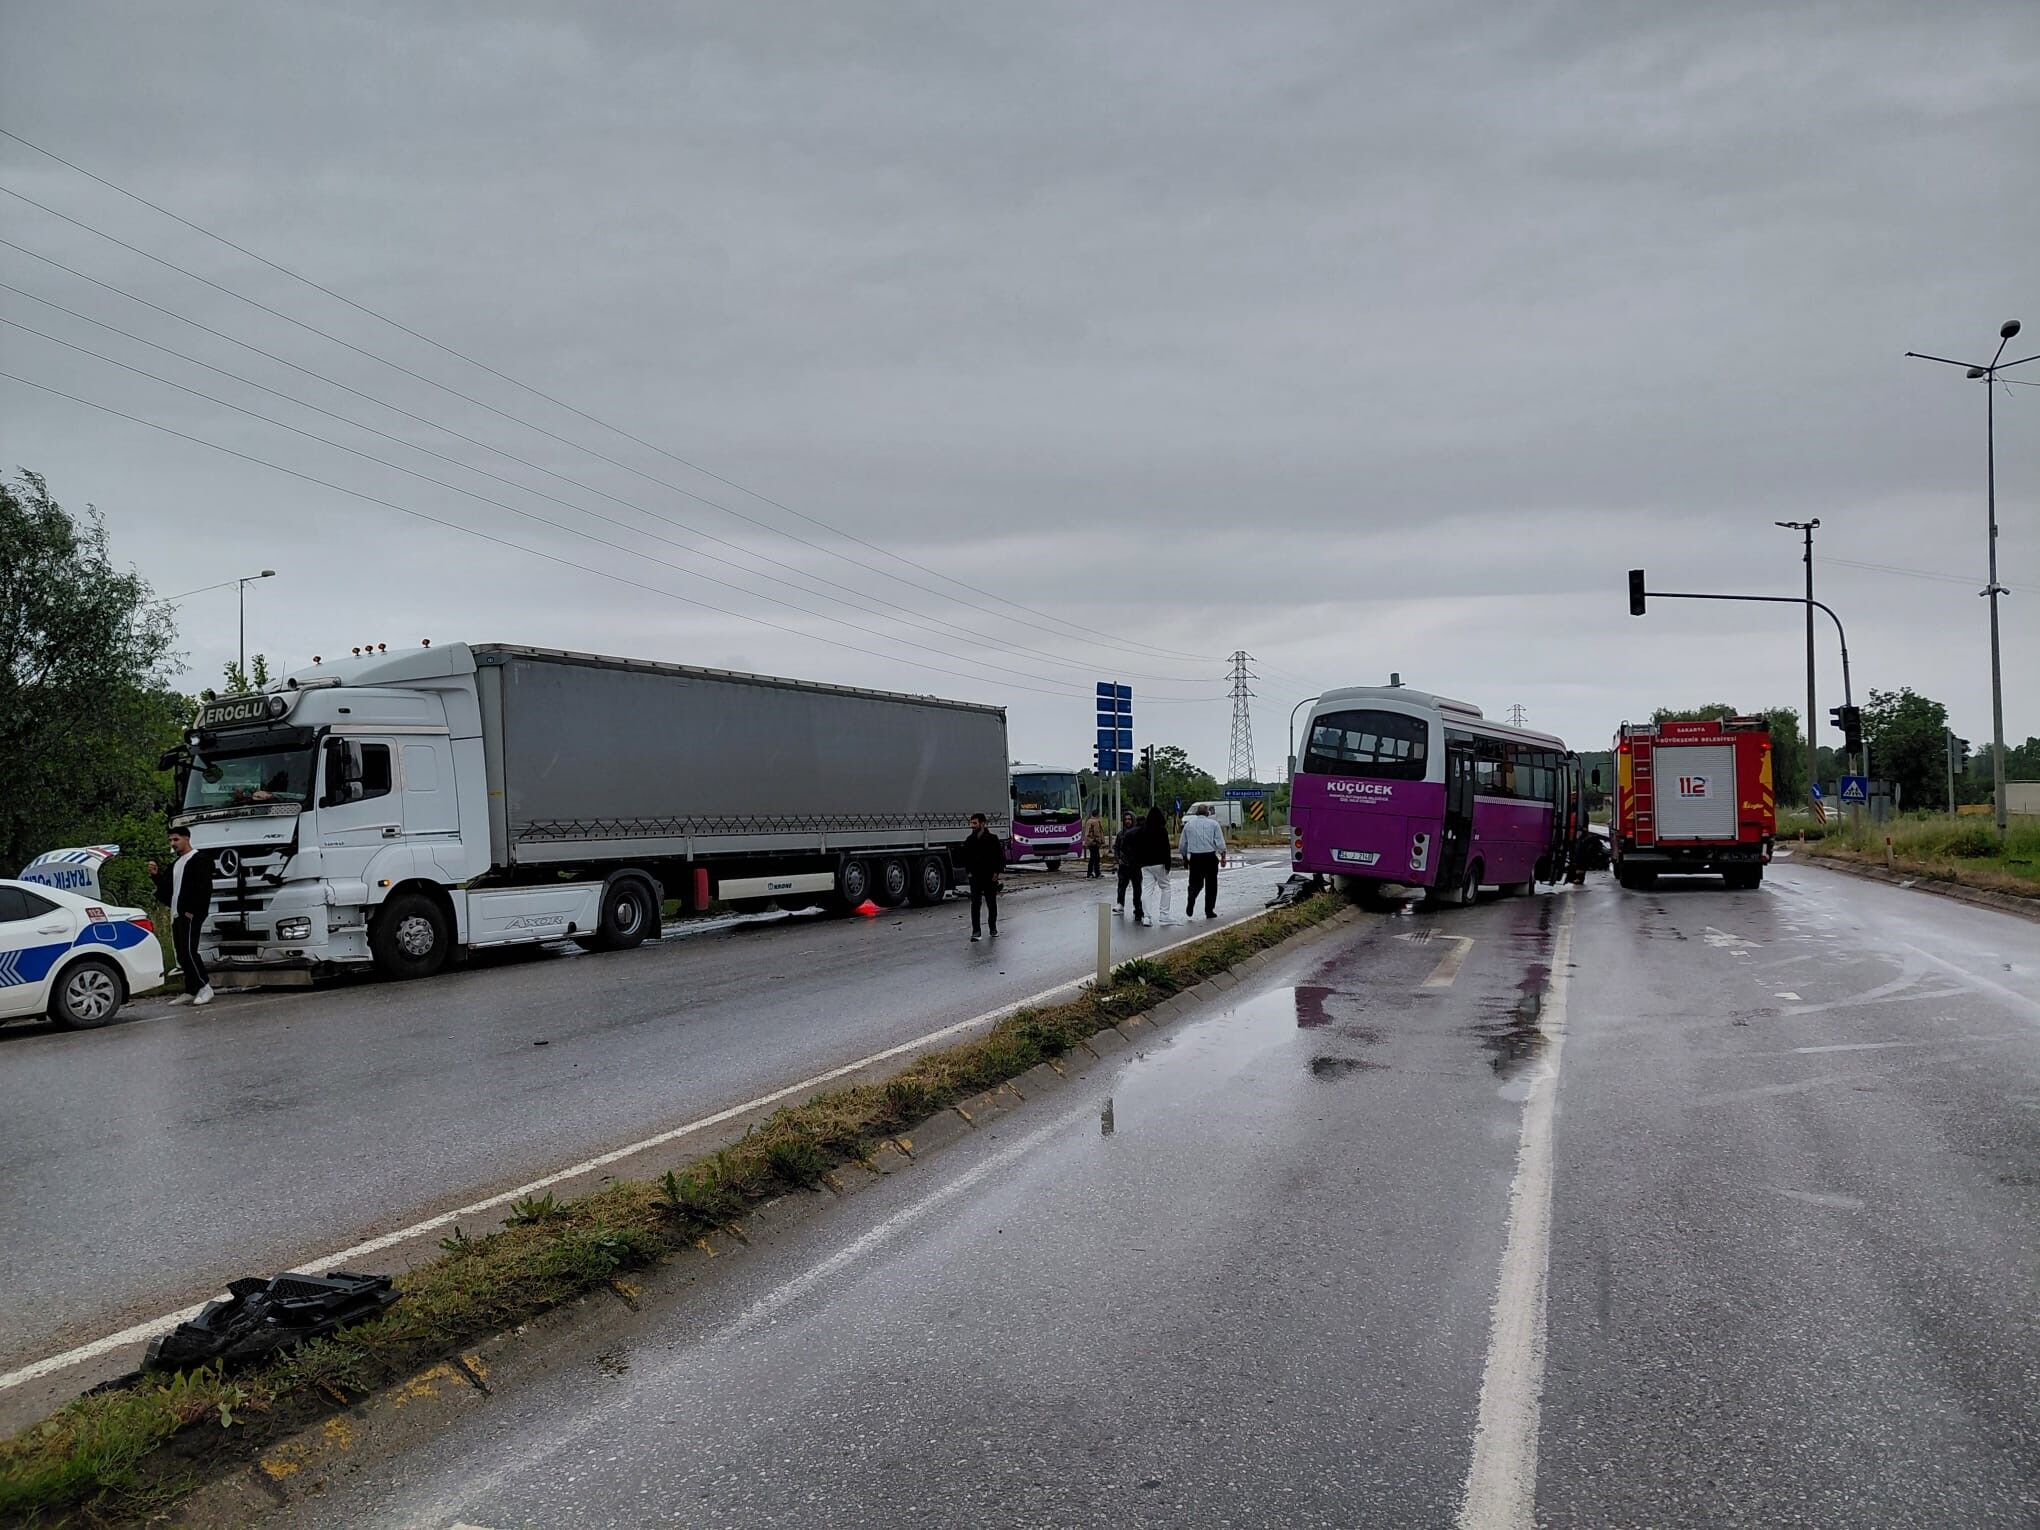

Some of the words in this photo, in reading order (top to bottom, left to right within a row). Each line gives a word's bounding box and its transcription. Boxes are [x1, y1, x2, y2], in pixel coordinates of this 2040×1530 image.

[1327, 780, 1393, 796] KÜÇÜCEK
[1679, 776, 1706, 794] 112
[1034, 824, 1068, 835] KÜÇÜCEK
